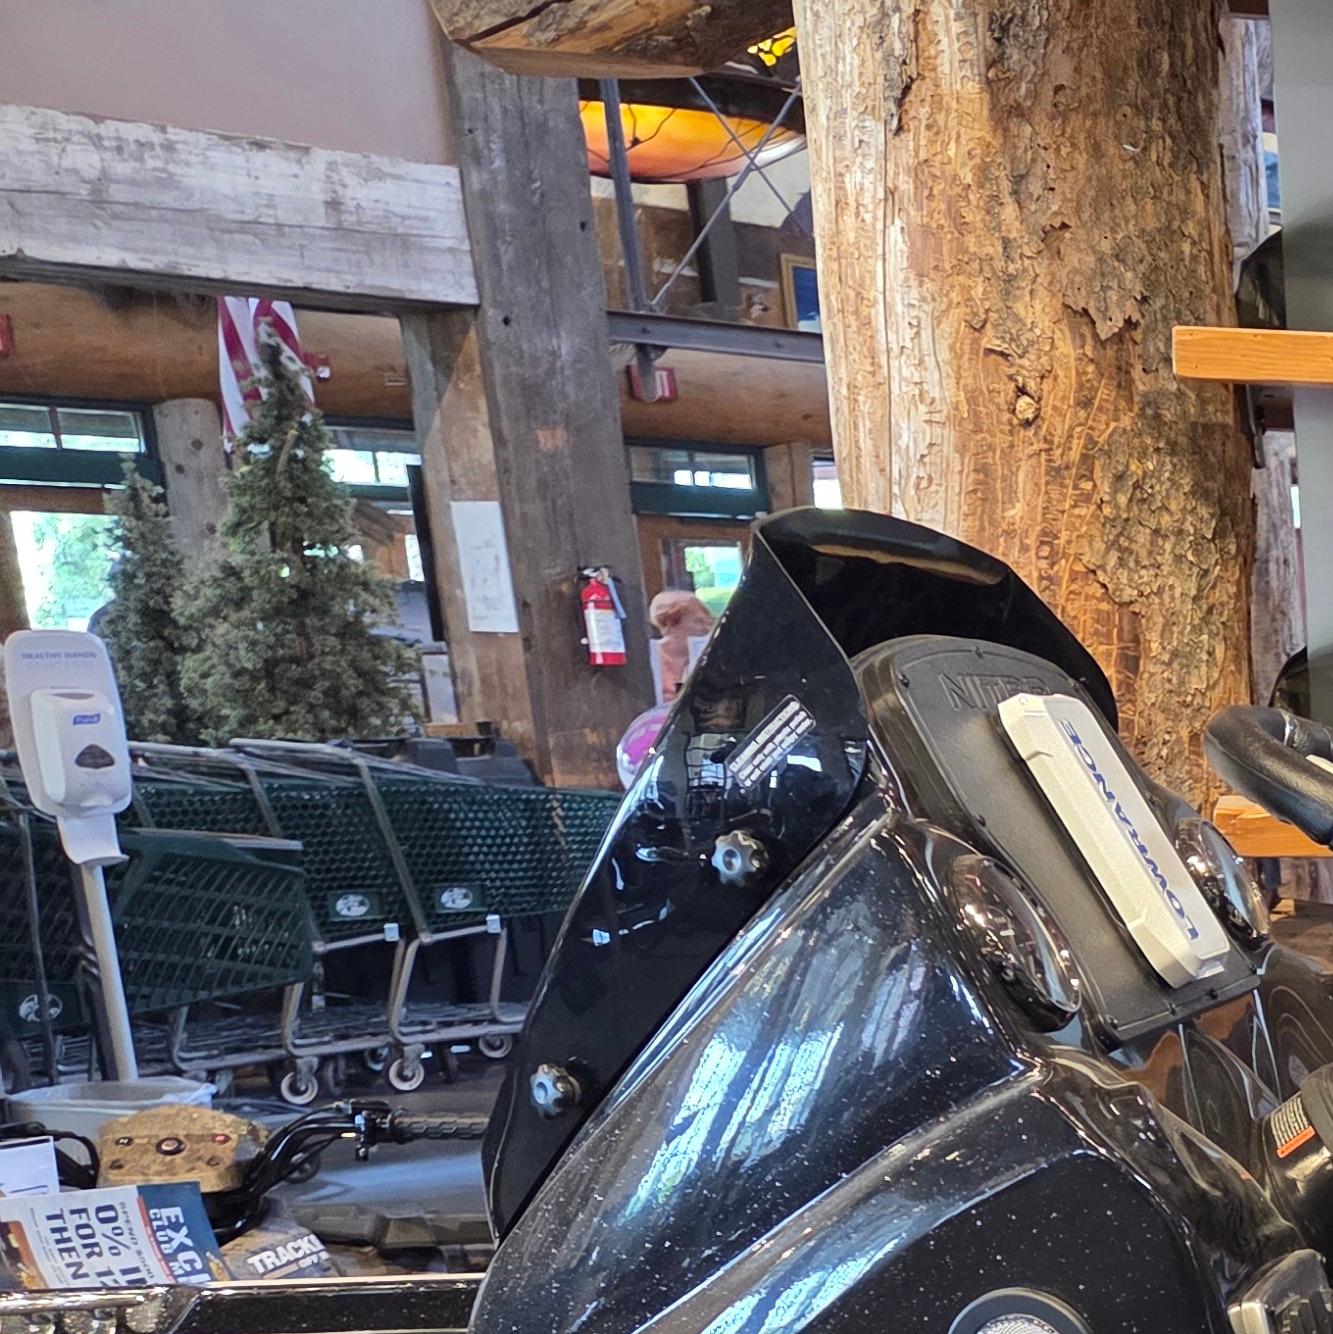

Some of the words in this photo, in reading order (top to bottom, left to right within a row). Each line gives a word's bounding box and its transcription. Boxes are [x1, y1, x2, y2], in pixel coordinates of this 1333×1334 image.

[1059, 718, 1200, 941] LOWRANCE
[45, 1208, 90, 1280] THEN
[69, 1207, 103, 1259] FOR
[95, 1203, 130, 1257] 0%
[149, 1209, 173, 1255] CLUB
